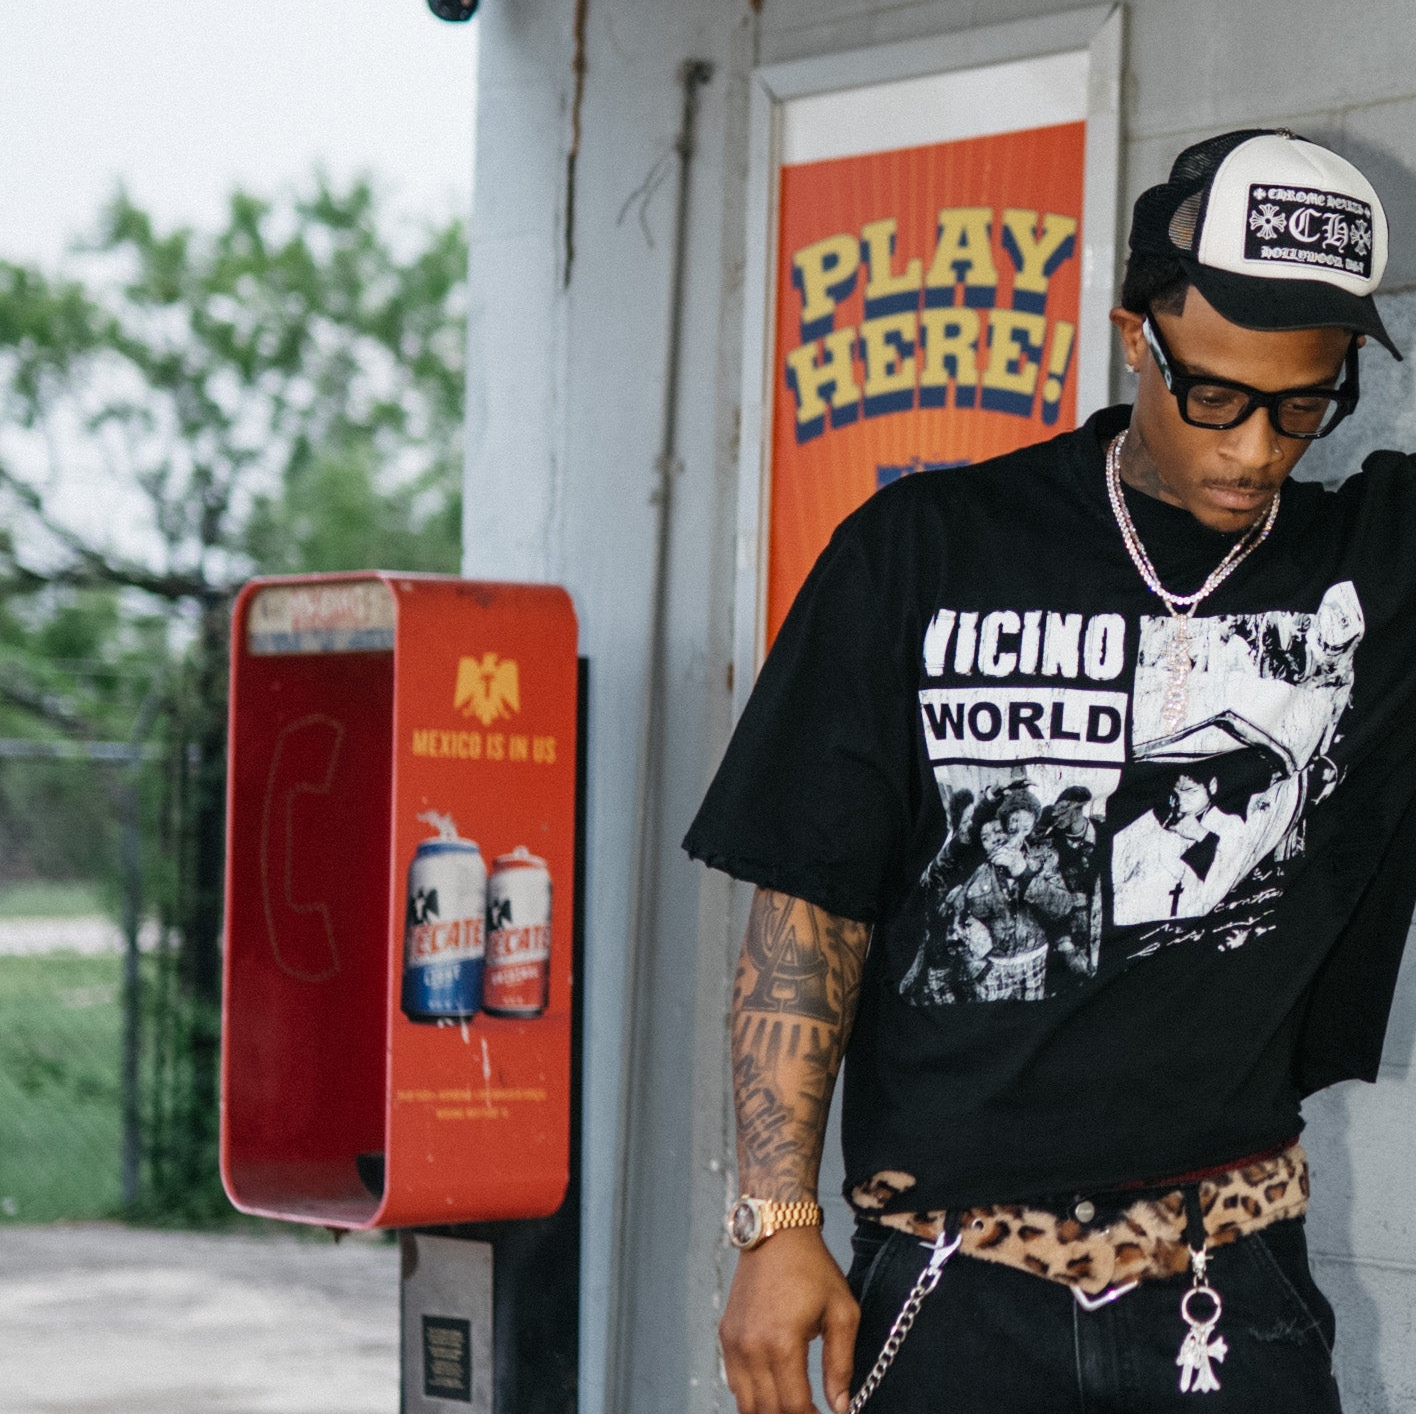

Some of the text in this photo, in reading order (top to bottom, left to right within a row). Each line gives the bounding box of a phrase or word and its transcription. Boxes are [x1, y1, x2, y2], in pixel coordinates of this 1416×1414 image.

[1288, 207, 1349, 253] CH
[792, 207, 1077, 337] PLAY
[786, 306, 1076, 439] HERE!
[923, 608, 1126, 681] VICINO
[412, 729, 557, 763] MEXICO IS IN US
[923, 701, 1122, 743] WORLD
